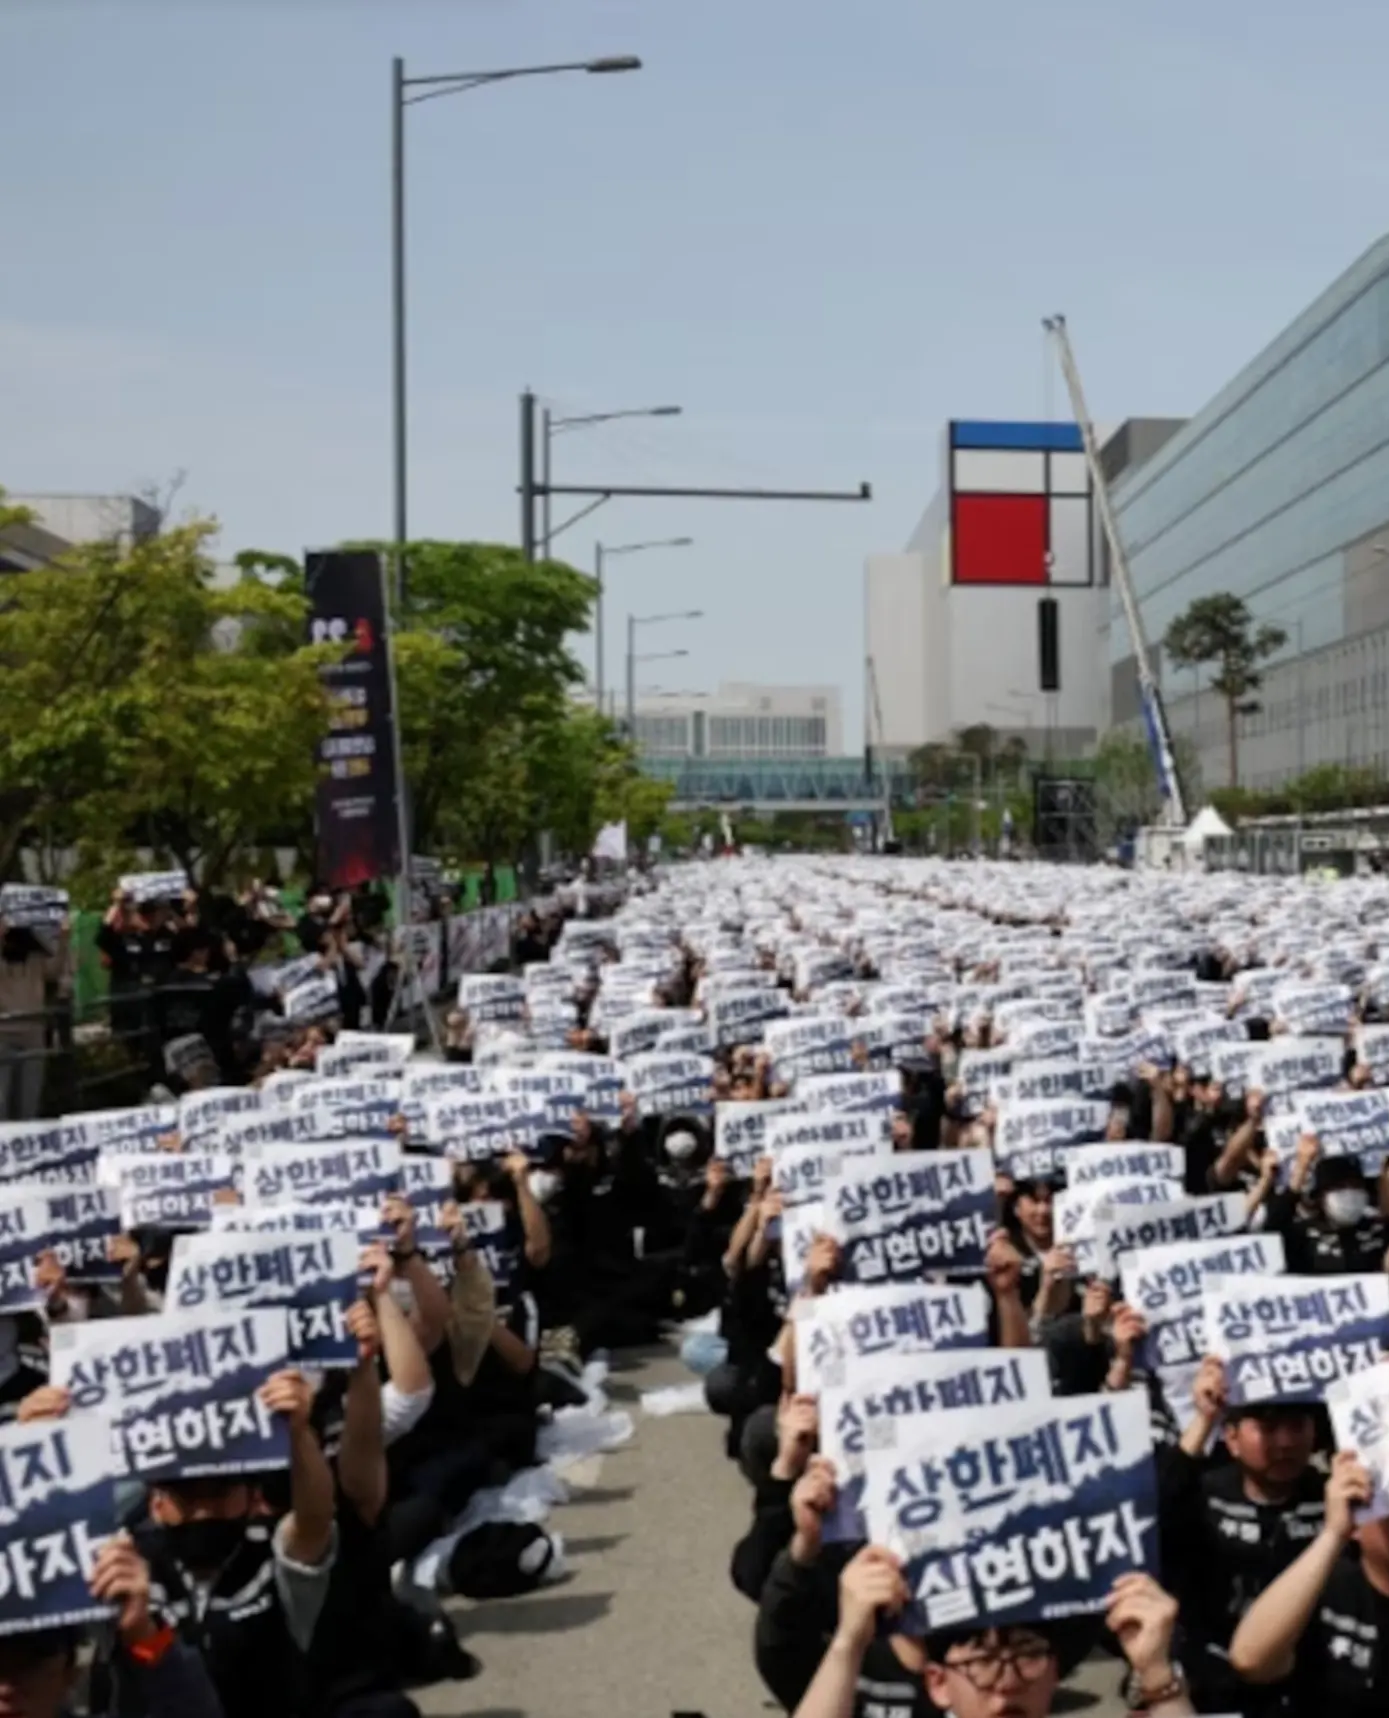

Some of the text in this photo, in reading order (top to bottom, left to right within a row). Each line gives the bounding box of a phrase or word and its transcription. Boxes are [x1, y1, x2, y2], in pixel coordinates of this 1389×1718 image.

[1005, 1106, 1097, 1143] 상한폐지
[1305, 1091, 1389, 1123] 상한폐지
[255, 1144, 382, 1196] 상한폐지
[837, 1155, 974, 1222] 상한폐지
[1075, 1151, 1173, 1185] 상한폐지
[175, 1238, 335, 1303] 상한폐지
[851, 1212, 993, 1280] 실현하자
[1138, 1243, 1266, 1308] 상한폐지
[1217, 1282, 1367, 1340] 상한폐지
[69, 1319, 258, 1405] 상한폐지
[1237, 1339, 1383, 1398] 실현하자
[889, 1404, 1118, 1530] 상한폐지
[916, 1502, 1157, 1628] 실현하자
